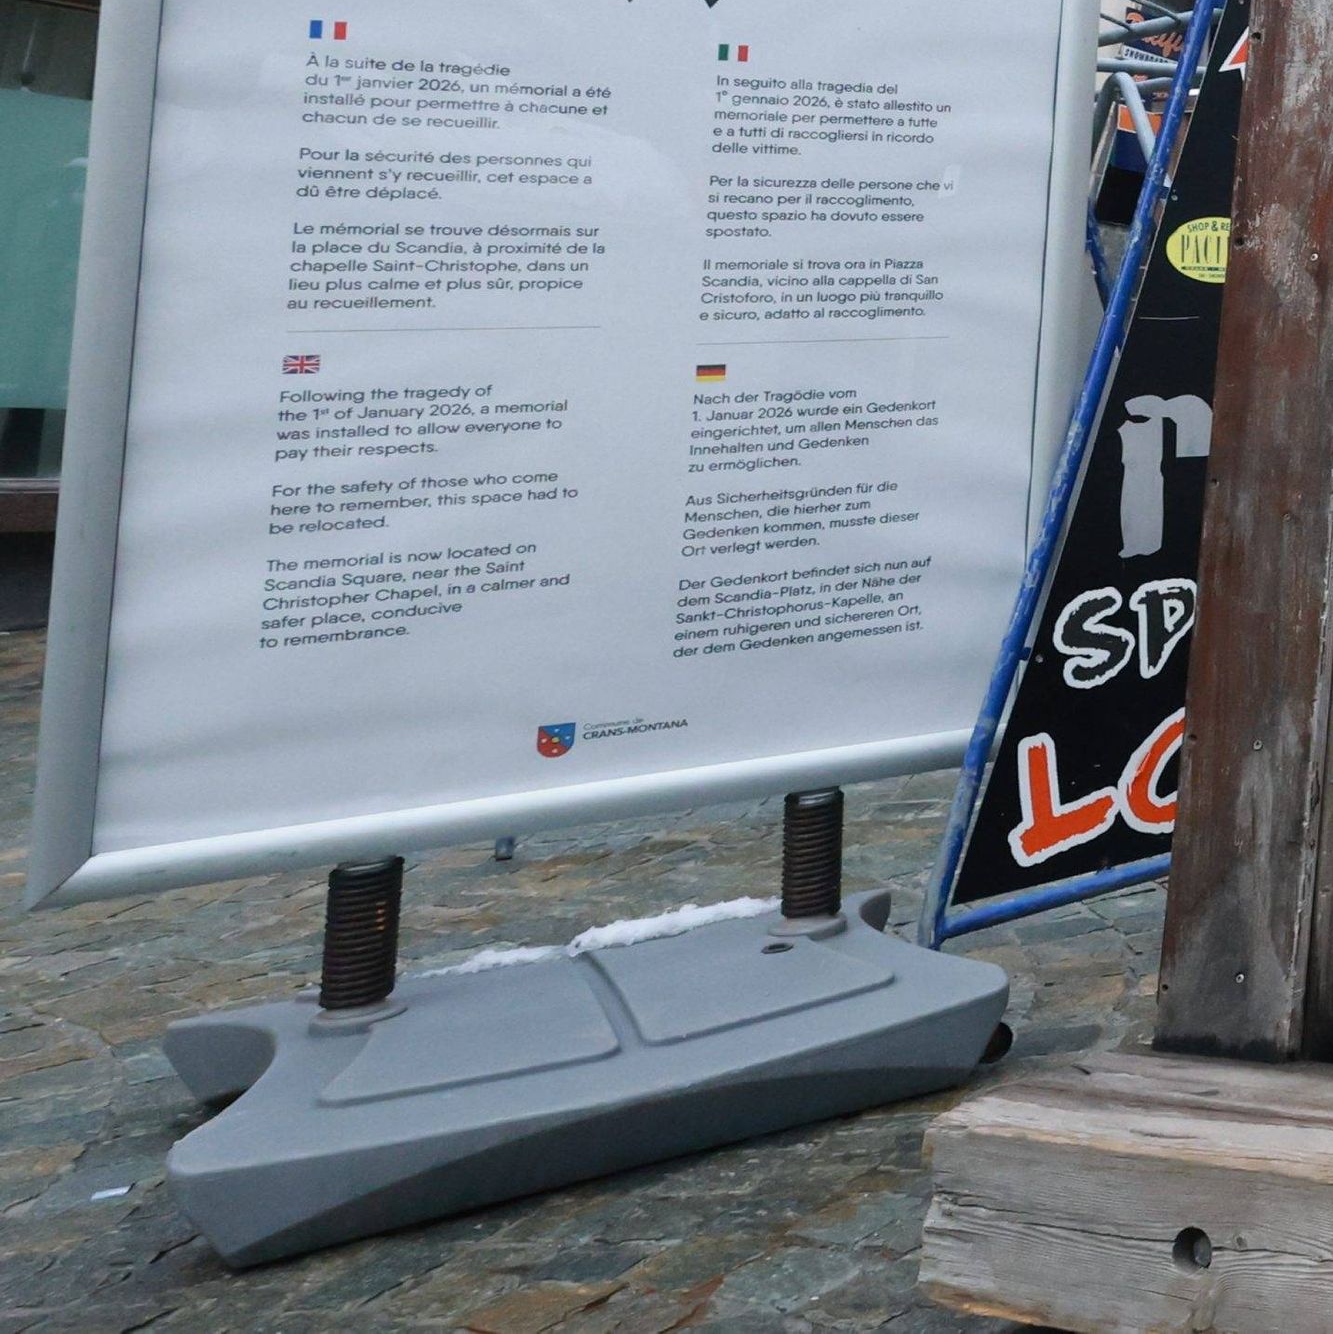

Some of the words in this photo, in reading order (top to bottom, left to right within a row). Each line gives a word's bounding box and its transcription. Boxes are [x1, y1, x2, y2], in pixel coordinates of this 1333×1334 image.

[306, 51, 320, 67] À
[325, 55, 339, 68] la
[344, 57, 387, 71] suite
[391, 59, 416, 72] de
[420, 59, 434, 73] la
[438, 62, 511, 78] tragédie
[305, 73, 329, 86] du
[355, 75, 414, 91] janvier
[417, 78, 465, 94] 2026,
[469, 84, 490, 93] un
[494, 82, 568, 97] mémorial
[571, 88, 581, 97] a
[585, 86, 612, 99] été
[717, 74, 730, 86] In
[733, 77, 787, 91] seguito
[790, 79, 813, 91] alla
[817, 81, 873, 95] tragedia
[876, 83, 898, 95] del
[304, 92, 366, 106] installé
[370, 97, 412, 109] pour
[416, 99, 500, 112] permettre
[504, 100, 514, 112] à
[518, 101, 588, 115] chacune
[591, 105, 608, 116] et
[731, 94, 789, 107] gennaio
[793, 95, 831, 109] 2026,
[833, 97, 844, 109] è
[846, 99, 880, 110] stato
[883, 99, 933, 113] allestito
[936, 104, 952, 113] un
[302, 111, 367, 124] chacun
[372, 113, 397, 126] de
[401, 117, 422, 126] se
[426, 117, 500, 129] recueillir.
[714, 110, 788, 122] memoriale
[791, 114, 816, 125] per
[819, 115, 894, 127] permettere
[897, 118, 905, 127] a
[908, 116, 938, 128] tutte
[299, 147, 341, 161] Pour
[345, 148, 360, 162] la
[365, 150, 435, 164] sécurité
[438, 151, 472, 164] des
[475, 155, 562, 167] personnes
[566, 156, 592, 169] qui
[297, 166, 374, 180] viennent
[378, 168, 402, 183] s'y
[406, 170, 481, 183] recueillir,
[486, 172, 515, 183] cet
[518, 174, 579, 186] espace
[583, 175, 592, 185] a
[296, 184, 320, 197] dû
[325, 185, 361, 198] être
[365, 186, 442, 202] déplacé.
[293, 222, 315, 235] Le
[319, 222, 400, 236] mémorial
[404, 226, 425, 236] se
[429, 224, 483, 236] trouve
[487, 224, 572, 237] désormais
[575, 227, 600, 237] sur
[1187, 223, 1209, 233] SHOP
[291, 240, 306, 253] la
[311, 240, 363, 256] place
[367, 241, 391, 254] du
[395, 241, 467, 255] Scandia,
[472, 242, 482, 254] à
[486, 242, 562, 257] proximité
[566, 242, 588, 254] de
[592, 242, 605, 254] la
[1181, 234, 1230, 264] PACI
[289, 259, 368, 275] chapelle
[372, 259, 522, 275] Saint-Christophe,
[526, 260, 566, 272] dans
[570, 262, 589, 272] un
[288, 278, 320, 291] lieu
[325, 278, 362, 293] plus
[367, 277, 420, 290] calme
[424, 278, 442, 290] et
[446, 277, 482, 293] plus
[486, 277, 514, 291] sûr,
[518, 277, 583, 292] propice
[286, 299, 308, 310] au
[313, 296, 436, 309] recueillement.
[279, 389, 365, 404] Following
[370, 388, 399, 400] the
[403, 385, 471, 402] tragedy
[474, 384, 493, 397] of
[693, 393, 731, 405] Nach
[734, 391, 759, 404] der
[763, 389, 825, 404] Tragödie
[828, 390, 857, 399] vom
[277, 409, 308, 422] the
[333, 407, 354, 420] of
[357, 406, 425, 420] January
[429, 403, 476, 417] 2026,
[480, 405, 490, 415] a
[495, 399, 568, 414] memorial
[692, 410, 702, 422] 1.
[705, 410, 754, 422] Januar
[757, 406, 793, 419] 2026
[796, 405, 839, 417] wurde
[842, 403, 863, 415] ein
[866, 400, 936, 414] Gedenkort
[276, 430, 310, 441] was
[315, 424, 390, 439] installed
[394, 424, 413, 436] to
[417, 422, 461, 435] allow
[464, 421, 542, 434] everyone
[545, 418, 563, 430] to
[274, 449, 309, 463] pay
[312, 444, 354, 457] their
[358, 441, 439, 458] respects.
[272, 484, 302, 498] For
[306, 483, 336, 496] the
[340, 480, 394, 494] safety
[397, 477, 417, 490] of
[420, 476, 469, 489] those
[473, 473, 508, 486] who
[512, 473, 559, 484] come
[270, 504, 311, 516] here
[315, 502, 335, 513] to
[339, 496, 432, 512] remember,
[437, 493, 467, 506] this
[471, 492, 523, 506] space
[527, 487, 558, 501] had
[562, 487, 579, 498] to
[268, 523, 294, 535] be
[299, 515, 389, 533] relocated.
[583, 719, 688, 739] CRANS-MONTANA
